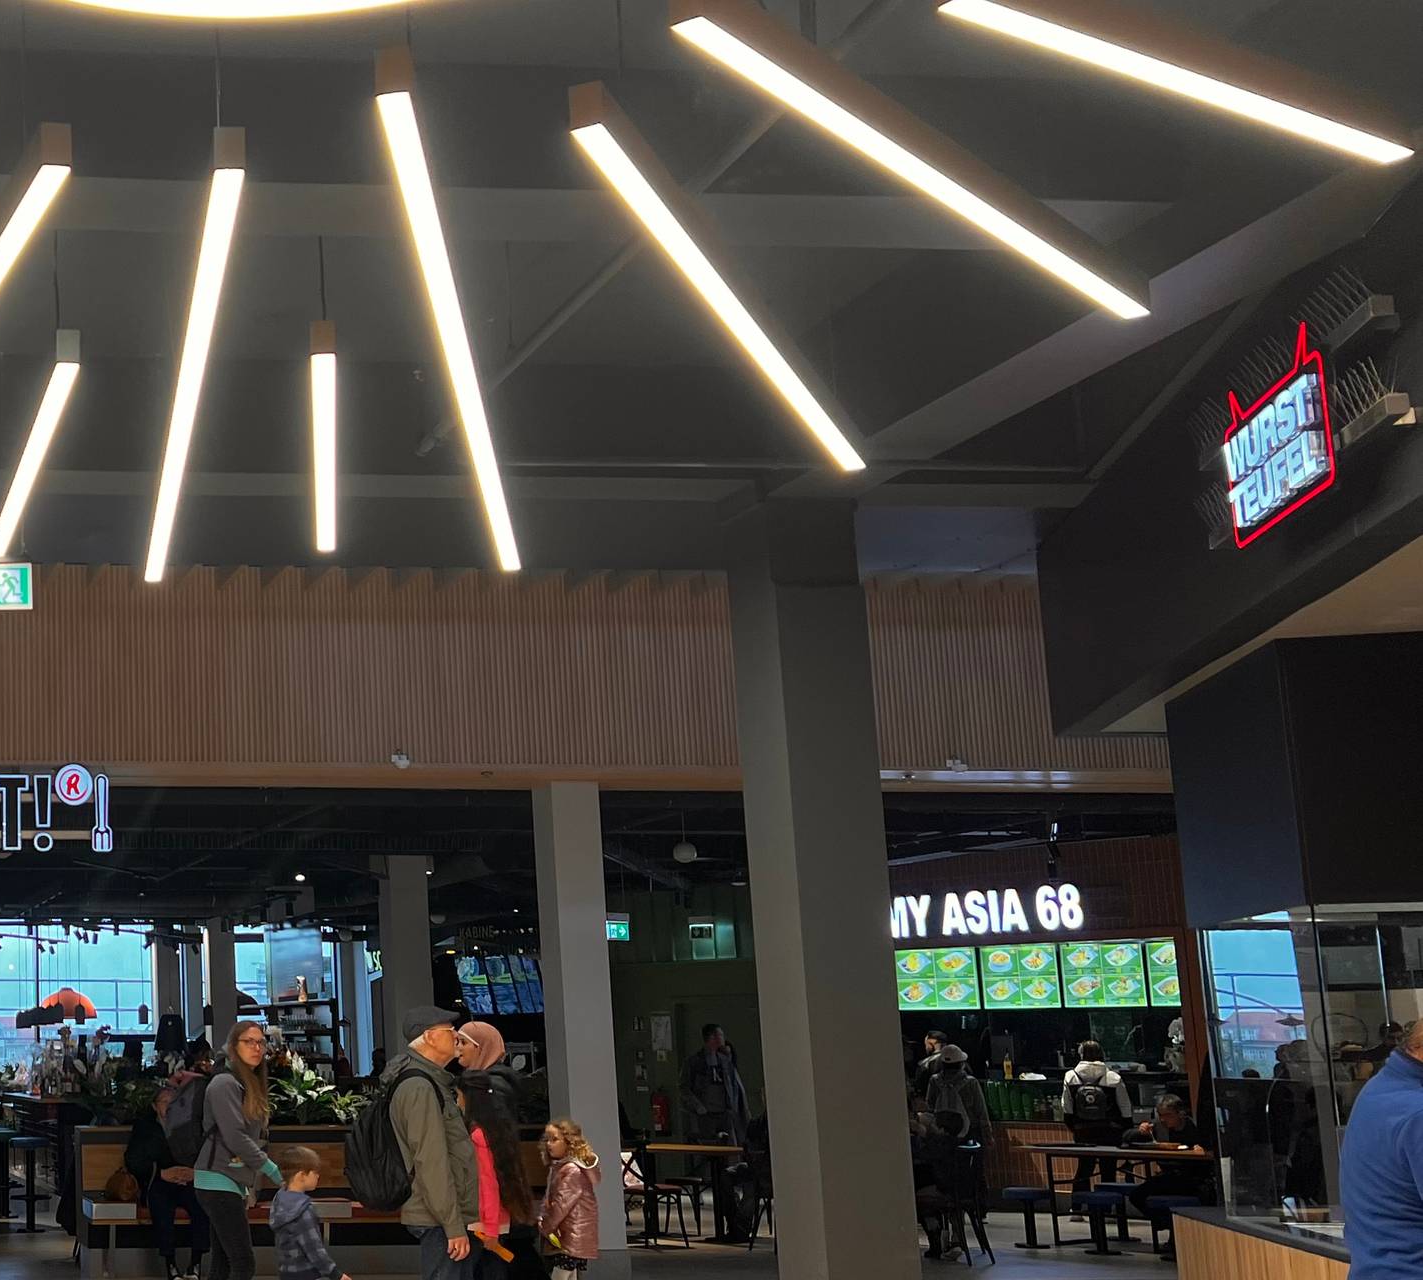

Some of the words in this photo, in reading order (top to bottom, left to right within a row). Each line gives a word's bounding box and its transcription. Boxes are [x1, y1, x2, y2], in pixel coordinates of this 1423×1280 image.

[1224, 373, 1310, 482] WURST
[1229, 431, 1318, 528] TEUFEL
[889, 895, 931, 938] MY
[942, 888, 1030, 936] ASIA
[1035, 883, 1084, 931] 68
